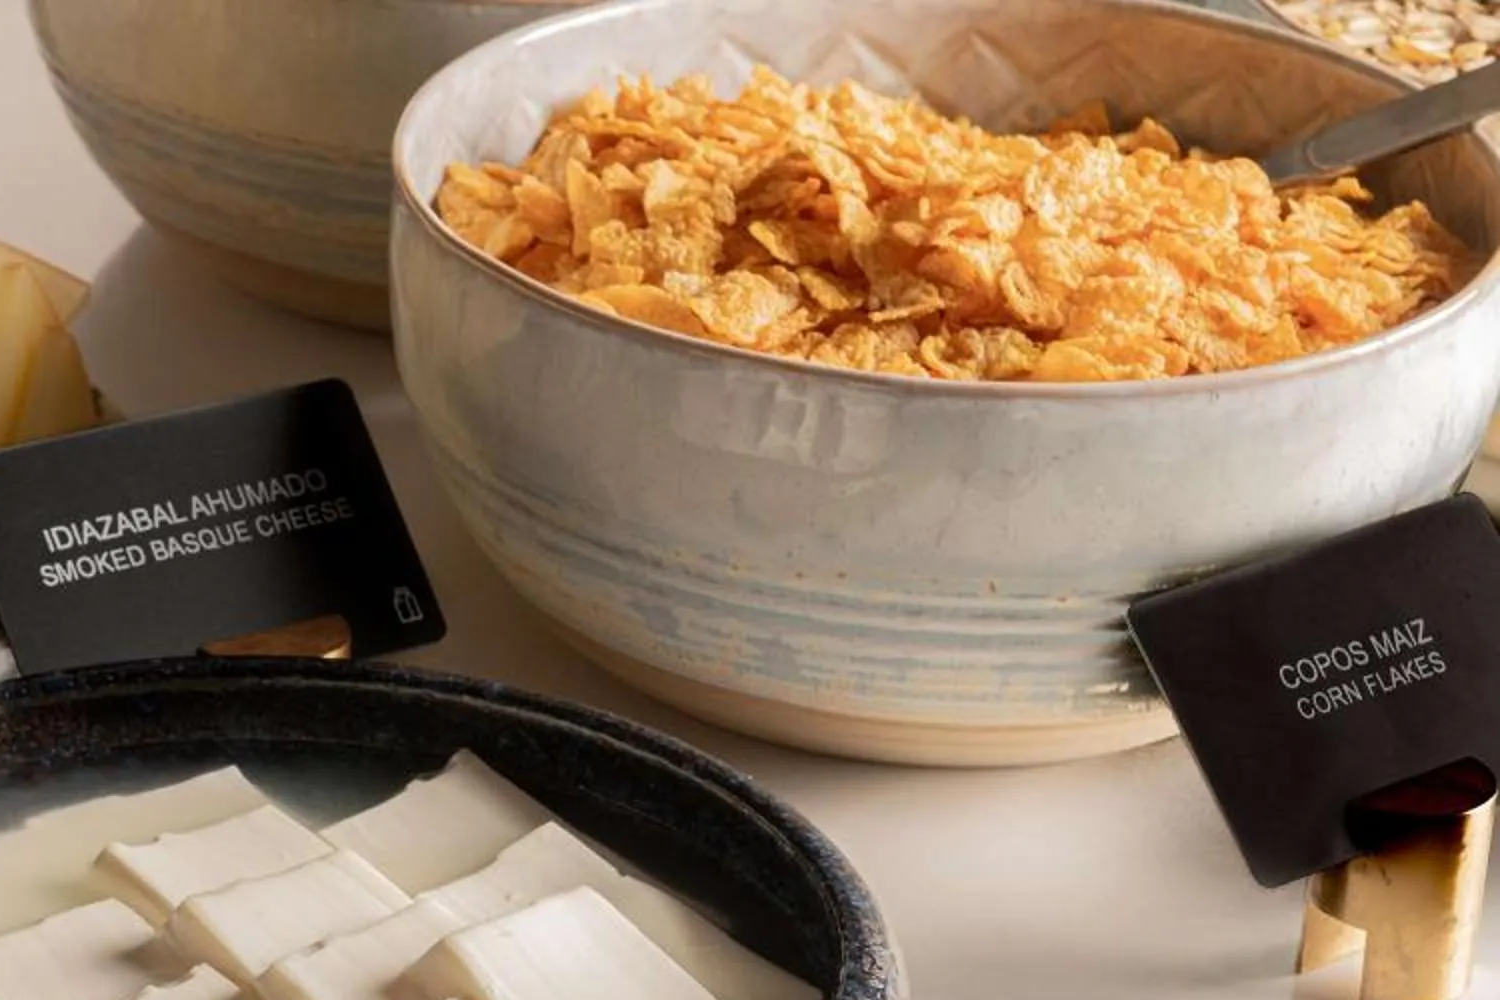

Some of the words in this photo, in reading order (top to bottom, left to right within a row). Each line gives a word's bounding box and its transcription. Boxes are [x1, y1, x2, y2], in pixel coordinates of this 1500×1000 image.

[40, 544, 147, 587] SMOKED
[151, 520, 252, 563] BASQUE
[255, 498, 354, 538] CHEESE
[42, 502, 188, 553] IDIAZABAL
[191, 468, 326, 520] AHUMADO
[1279, 641, 1369, 688] COPOS
[1369, 618, 1433, 659] MAIZ
[1297, 680, 1363, 719] CORN
[1363, 651, 1447, 696] FLAKES
